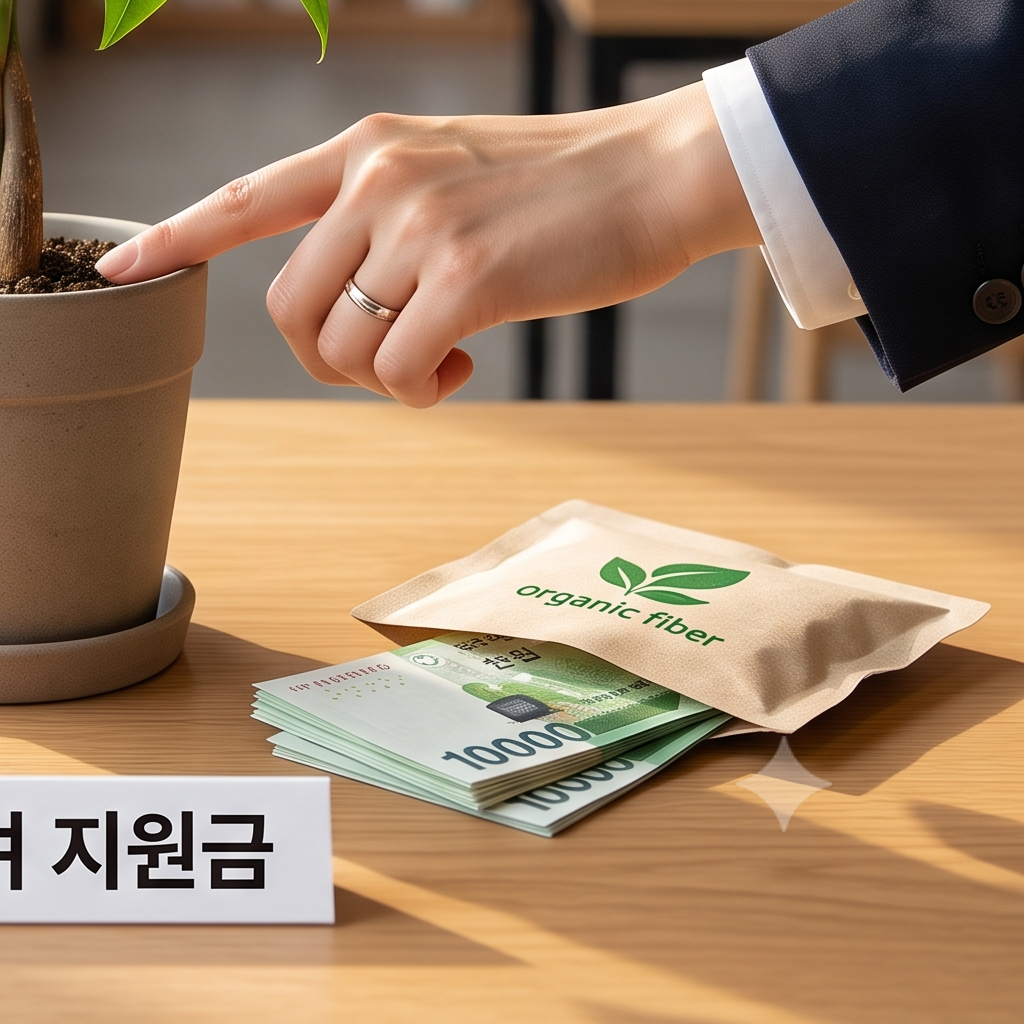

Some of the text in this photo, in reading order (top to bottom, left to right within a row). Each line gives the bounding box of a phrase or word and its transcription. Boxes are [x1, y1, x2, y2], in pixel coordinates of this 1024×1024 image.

[516, 585, 725, 647] organic fiber
[441, 722, 592, 771] 10000
[51, 810, 274, 890] 지원금
